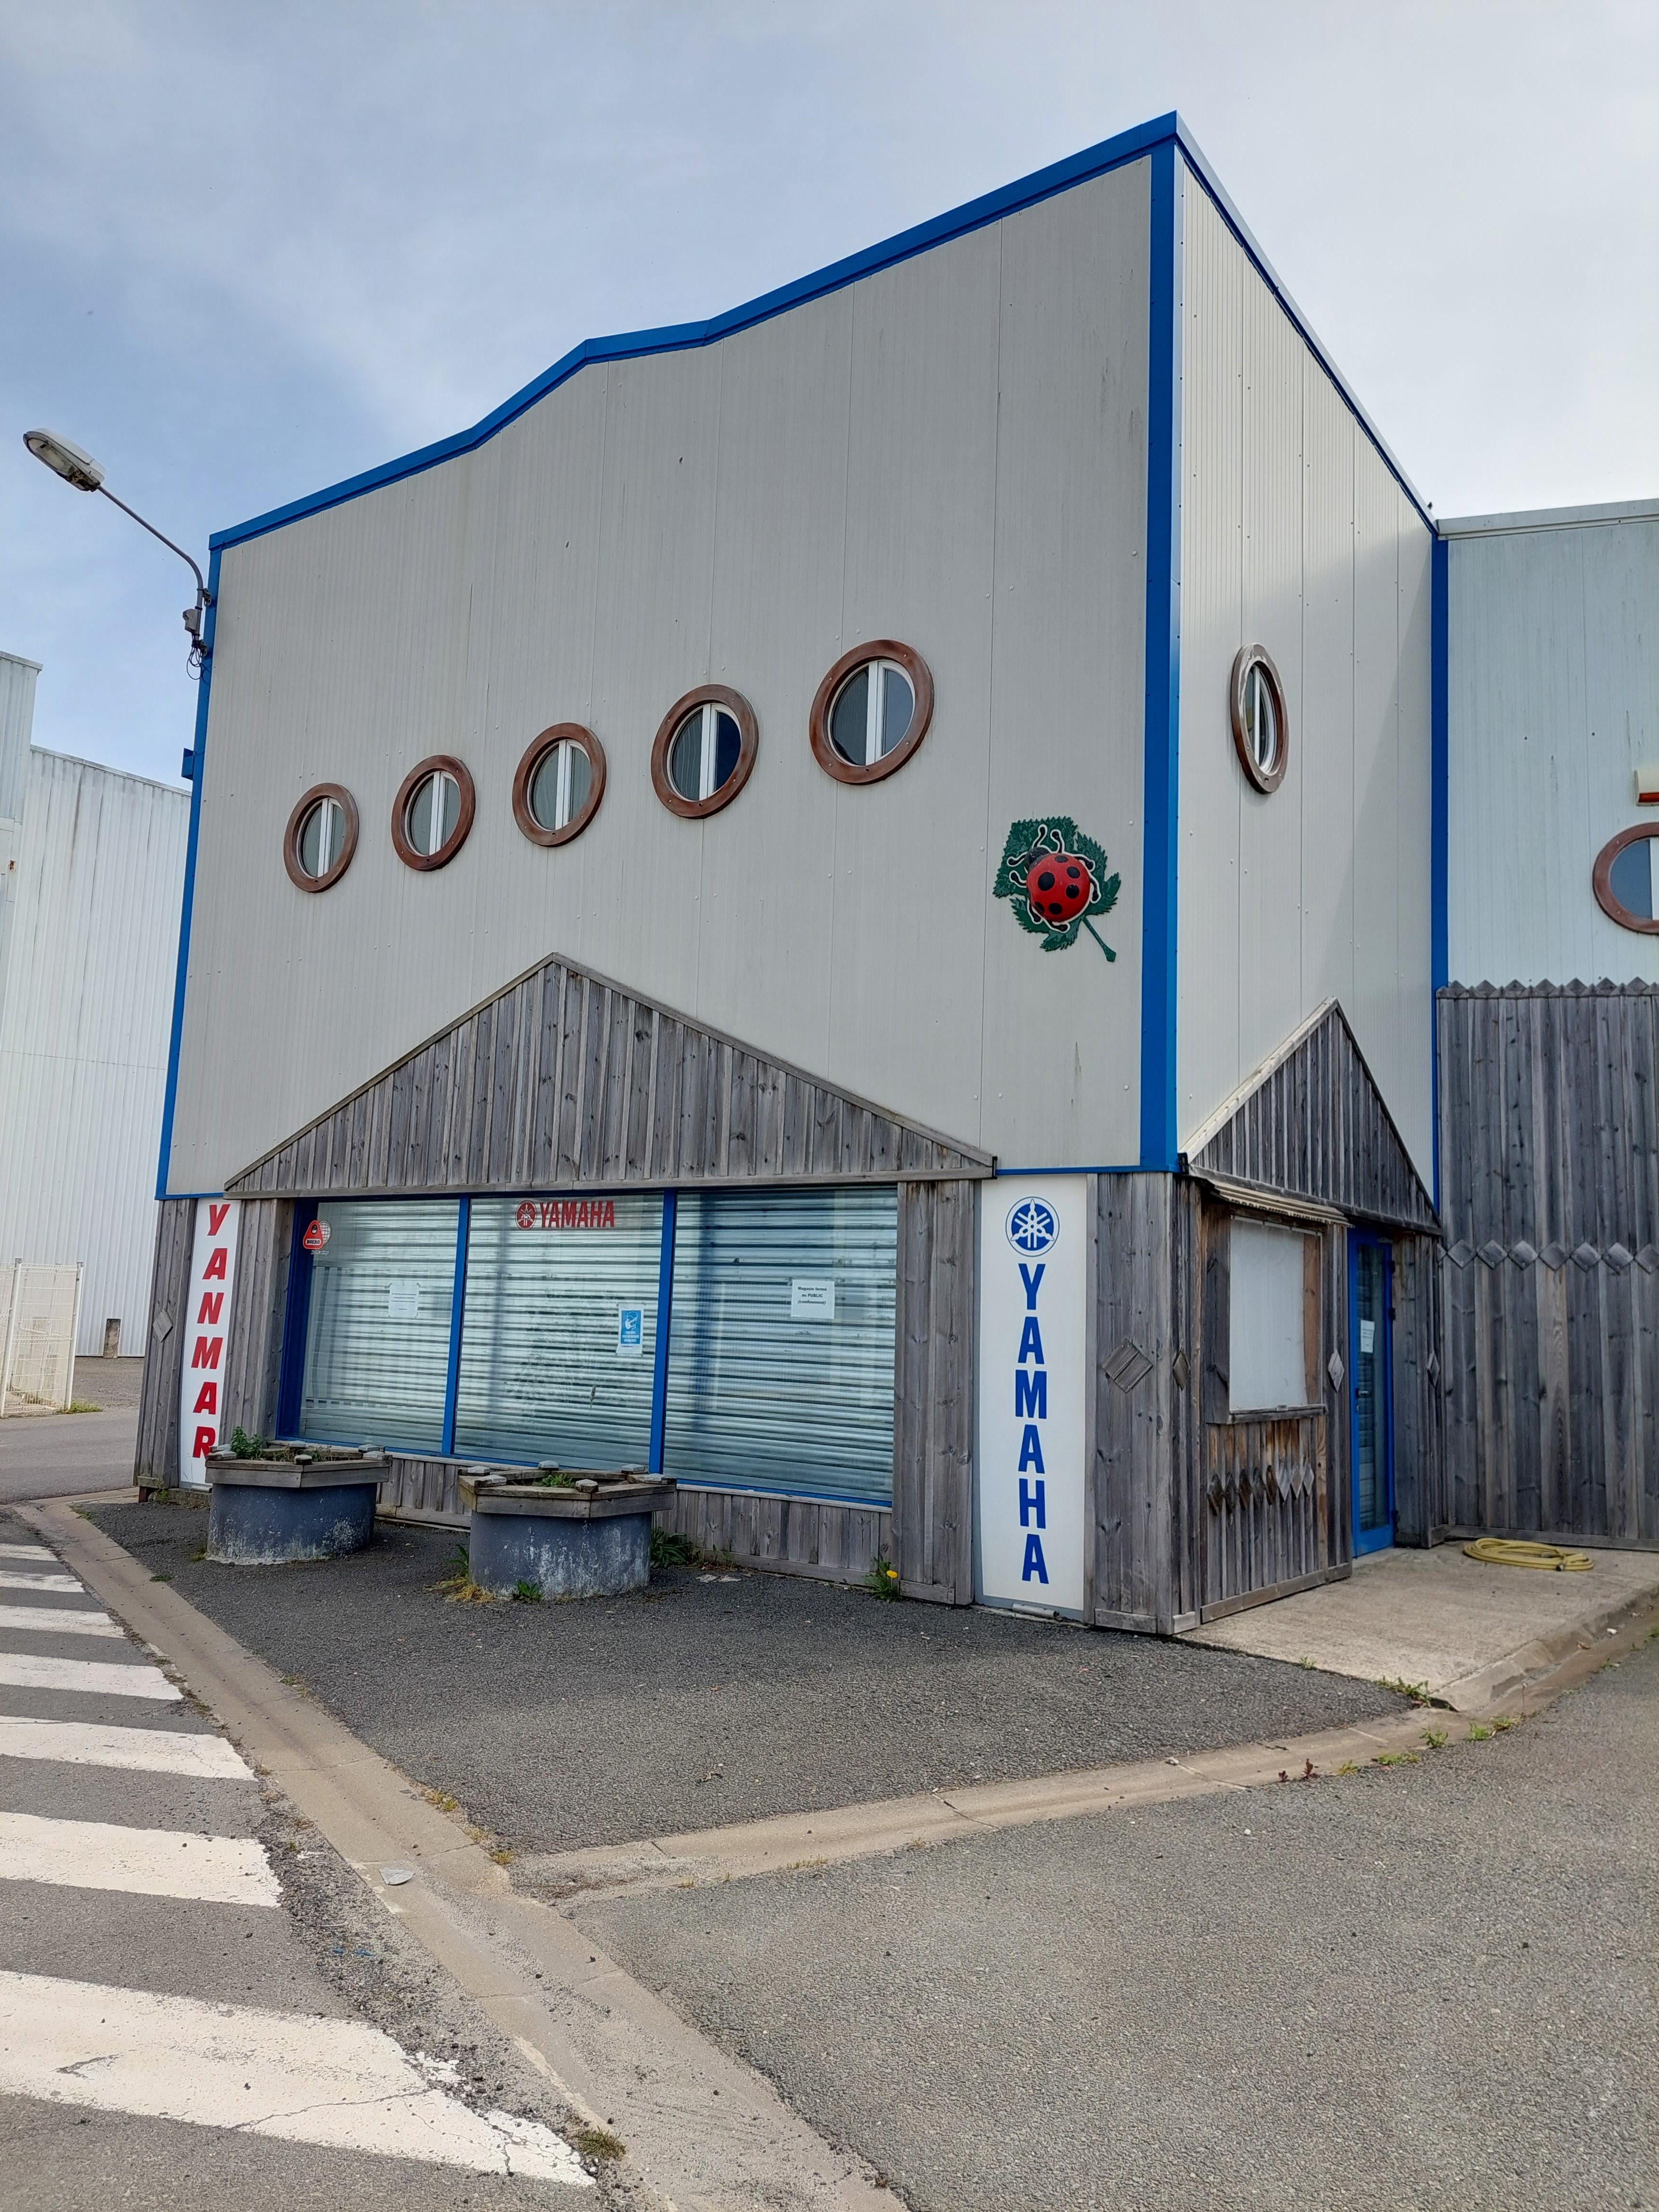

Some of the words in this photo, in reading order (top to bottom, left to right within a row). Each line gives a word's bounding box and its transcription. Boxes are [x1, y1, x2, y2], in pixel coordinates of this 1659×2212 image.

[191, 1204, 230, 1458] YANMAR
[540, 1200, 615, 1228] YAMAHA
[1014, 1263, 1050, 1585] YAMAHA
